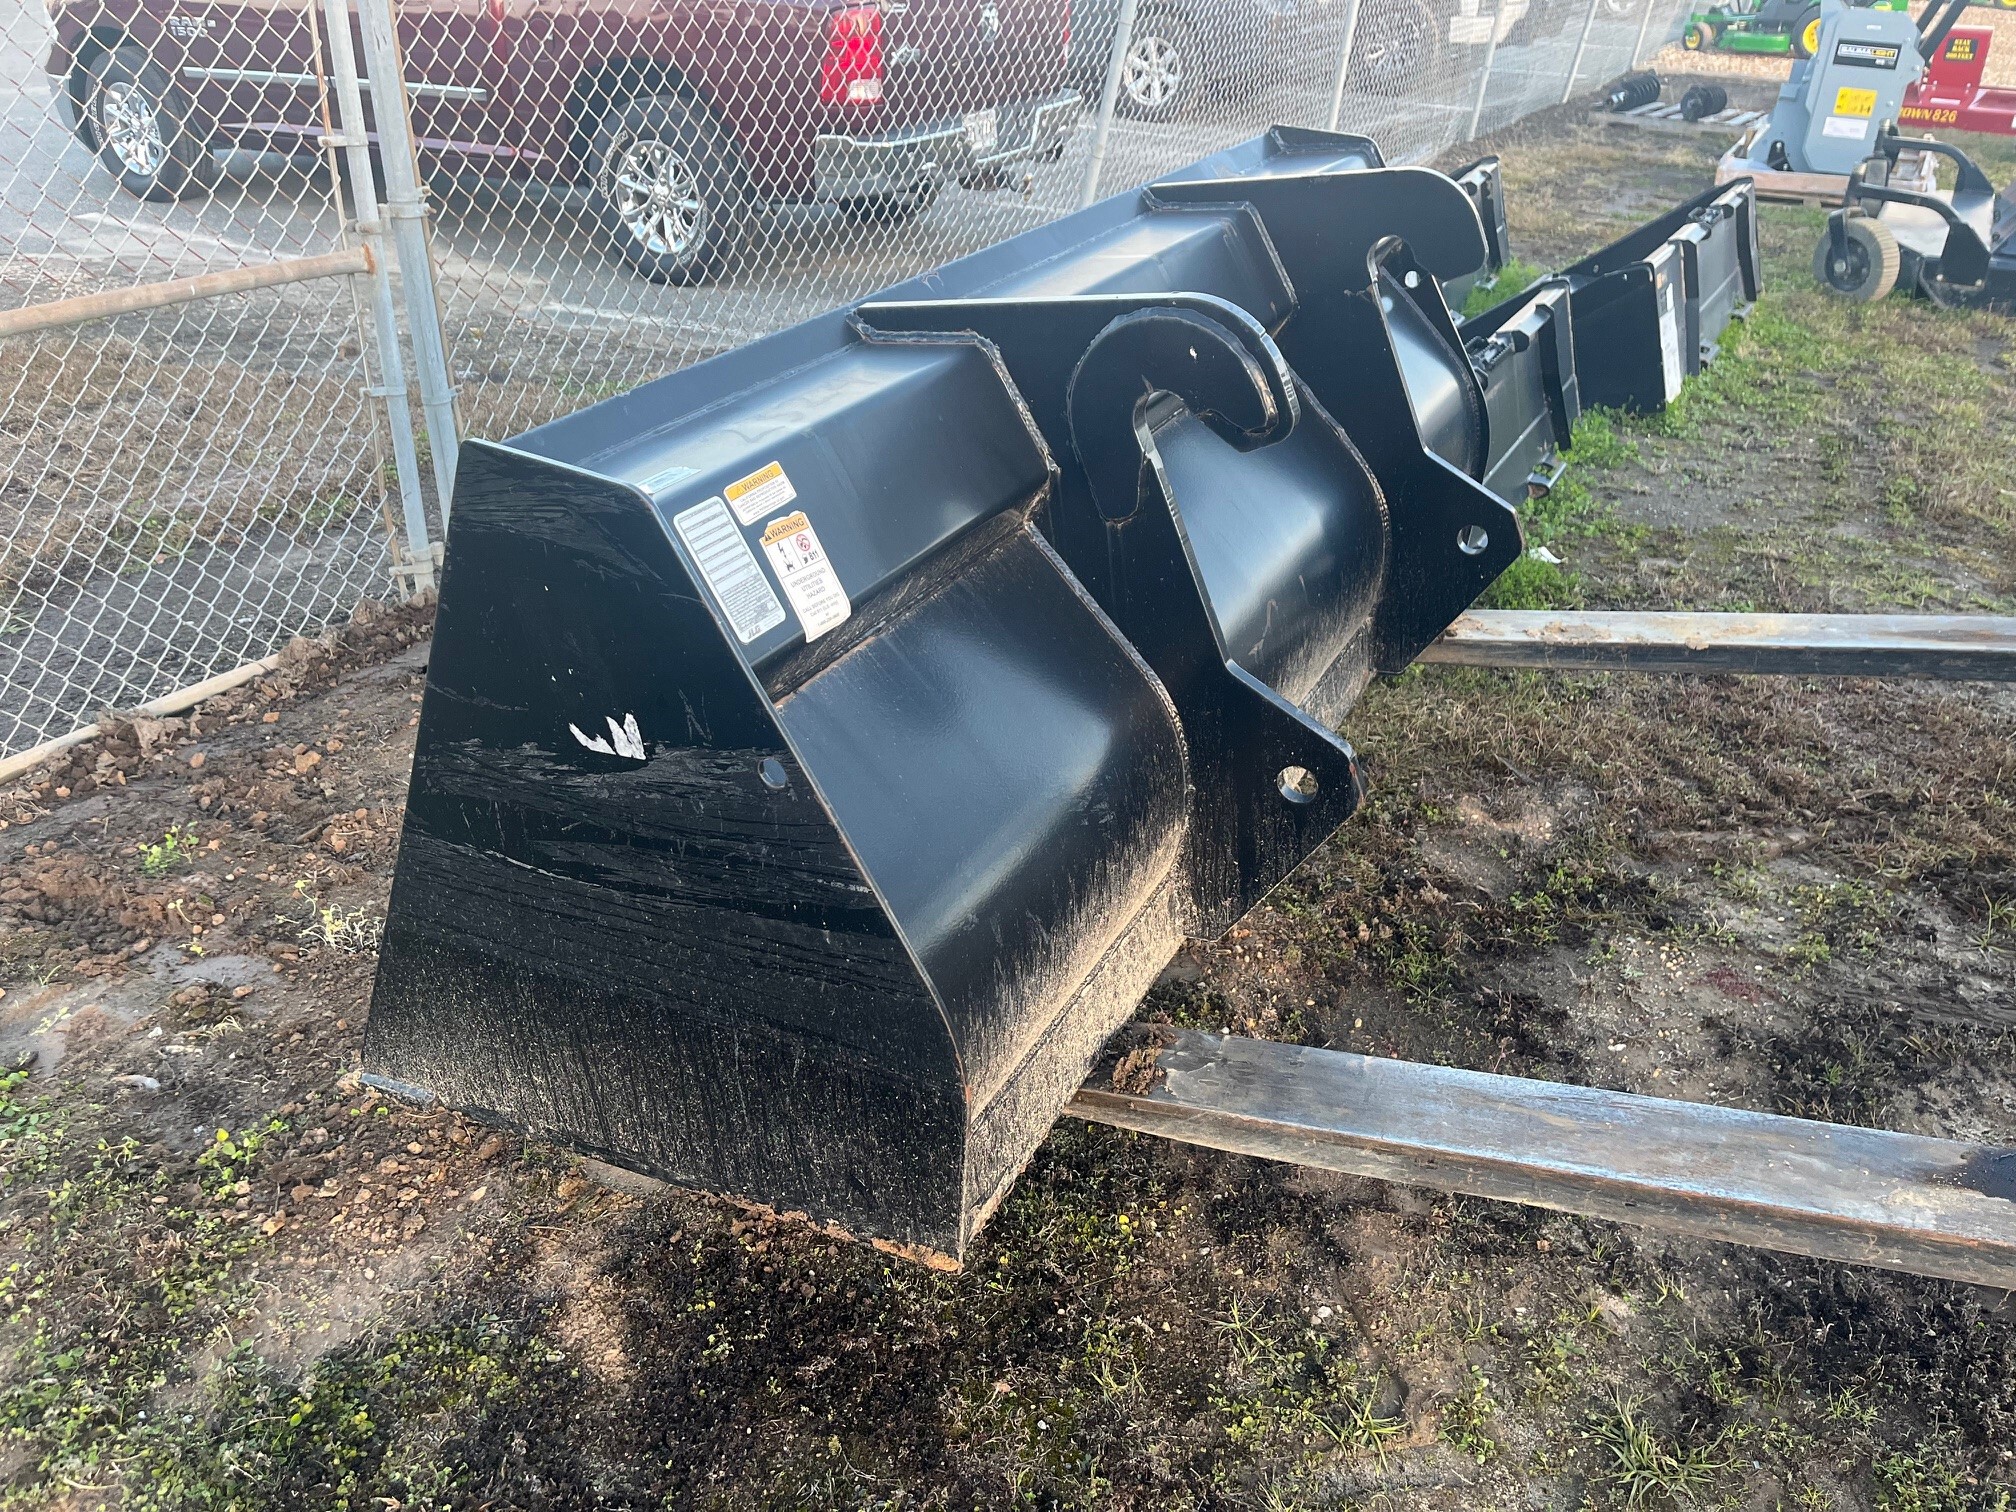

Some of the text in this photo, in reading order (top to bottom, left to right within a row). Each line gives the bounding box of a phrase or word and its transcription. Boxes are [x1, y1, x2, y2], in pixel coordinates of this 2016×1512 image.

[169, 16, 206, 27] RAM
[171, 27, 208, 38] 1500
[1900, 107, 1957, 123] OWN 826
[742, 469, 774, 491] WARNING
[770, 517, 805, 537] WARNING
[808, 550, 820, 561] 811
[791, 567, 826, 588] UNDERGROUND
[801, 577, 823, 591] UTILITIES
[806, 586, 826, 599] HAZARD
